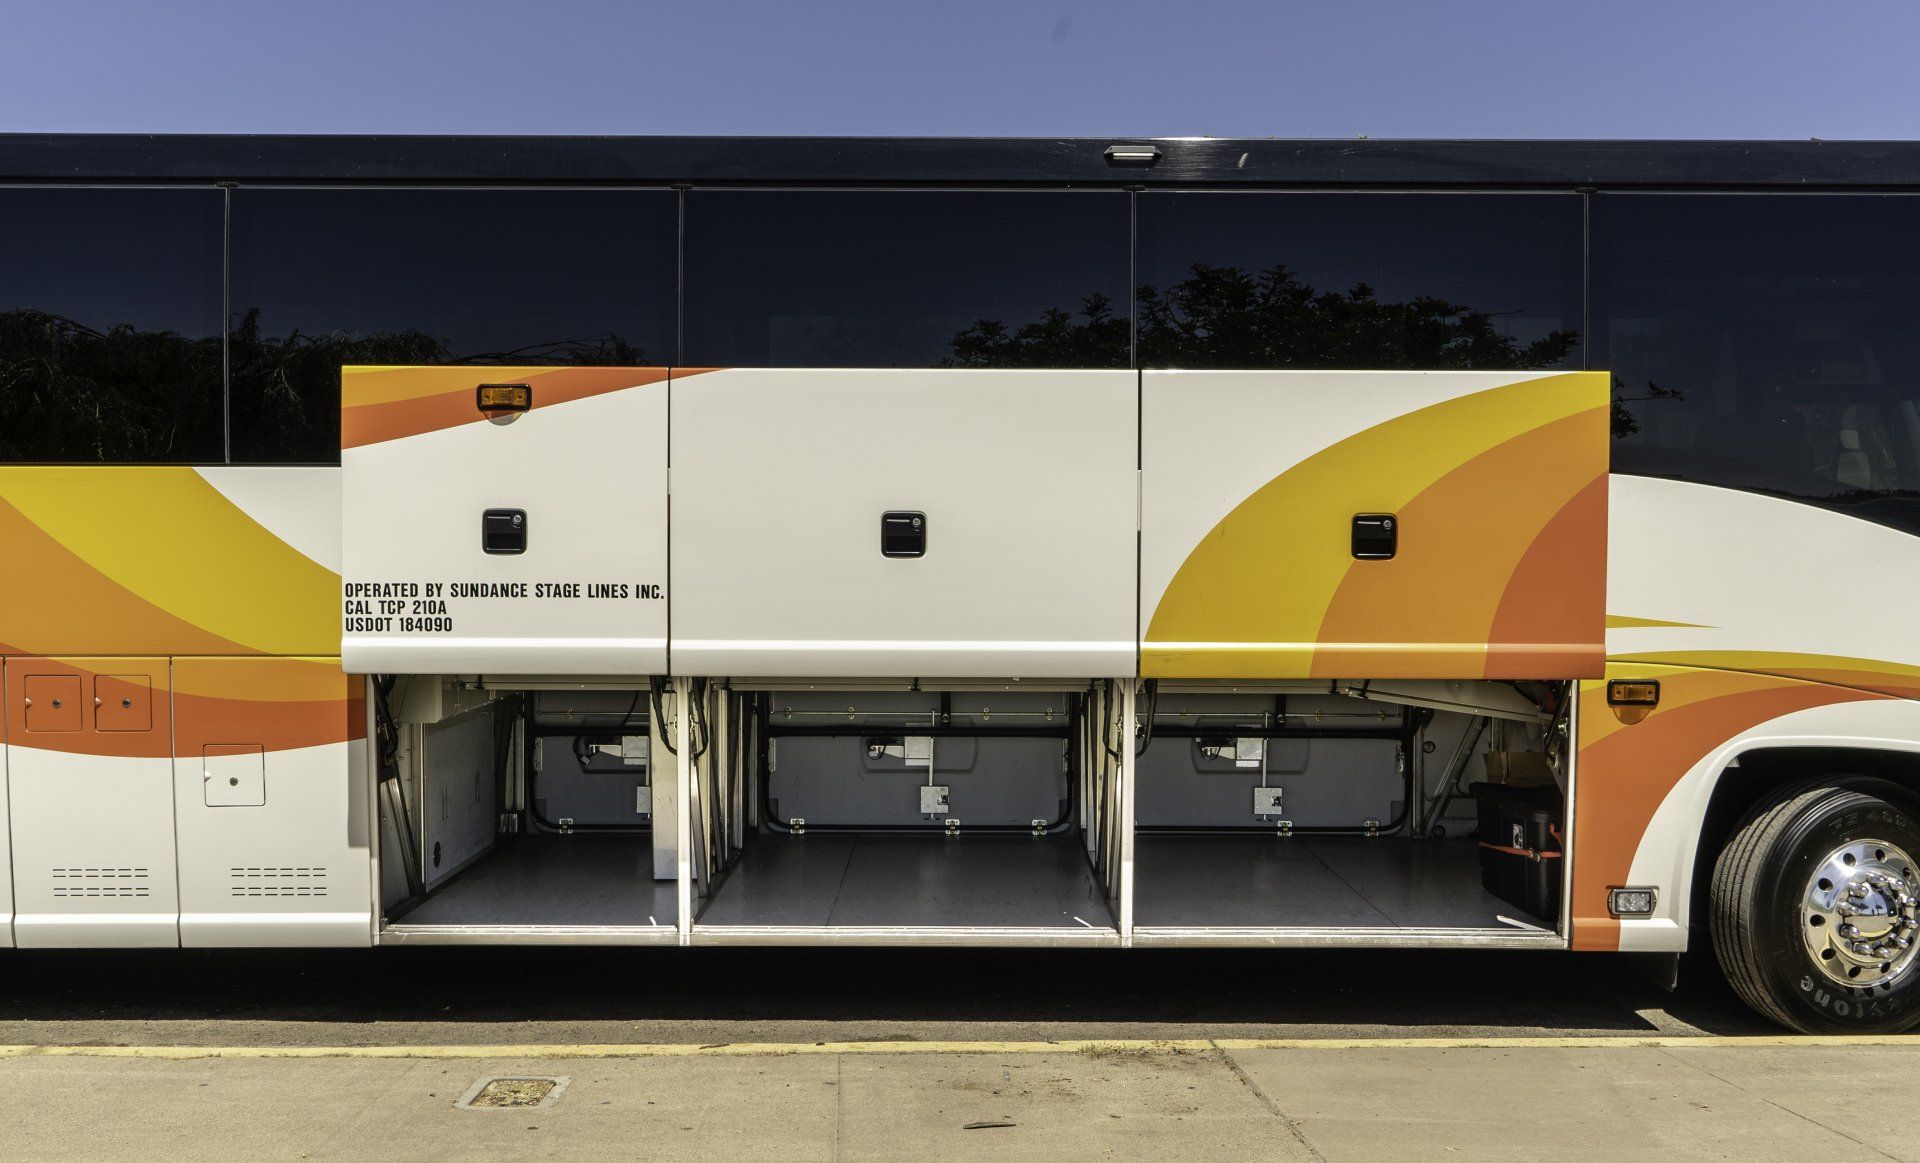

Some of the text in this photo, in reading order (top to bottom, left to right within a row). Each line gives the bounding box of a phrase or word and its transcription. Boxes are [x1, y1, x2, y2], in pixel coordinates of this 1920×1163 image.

[345, 582, 665, 599] OPERATED BY SUNDANCE STAGE LINES INC.
[345, 600, 447, 615] CAL TCP 210A
[345, 617, 453, 632] USDOT 184090
